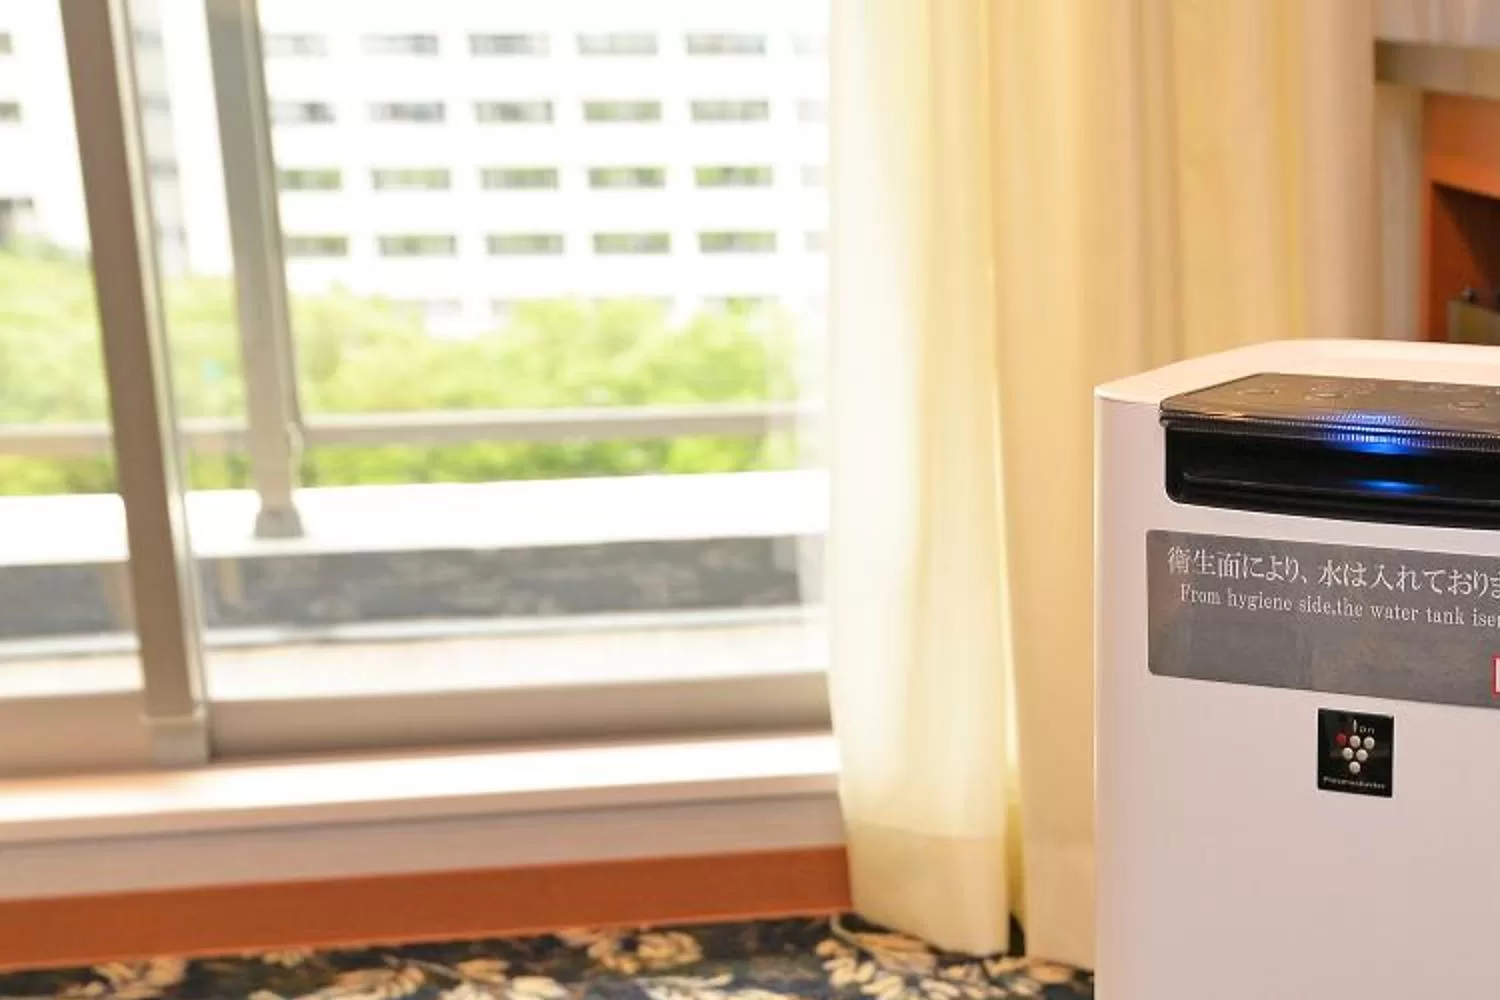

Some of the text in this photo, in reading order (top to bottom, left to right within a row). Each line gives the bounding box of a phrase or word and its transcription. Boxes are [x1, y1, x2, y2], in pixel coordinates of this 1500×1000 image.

[1180, 582, 1221, 605] From
[1227, 588, 1293, 612] hygiene
[1370, 604, 1419, 622] water
[1426, 606, 1465, 626] tank
